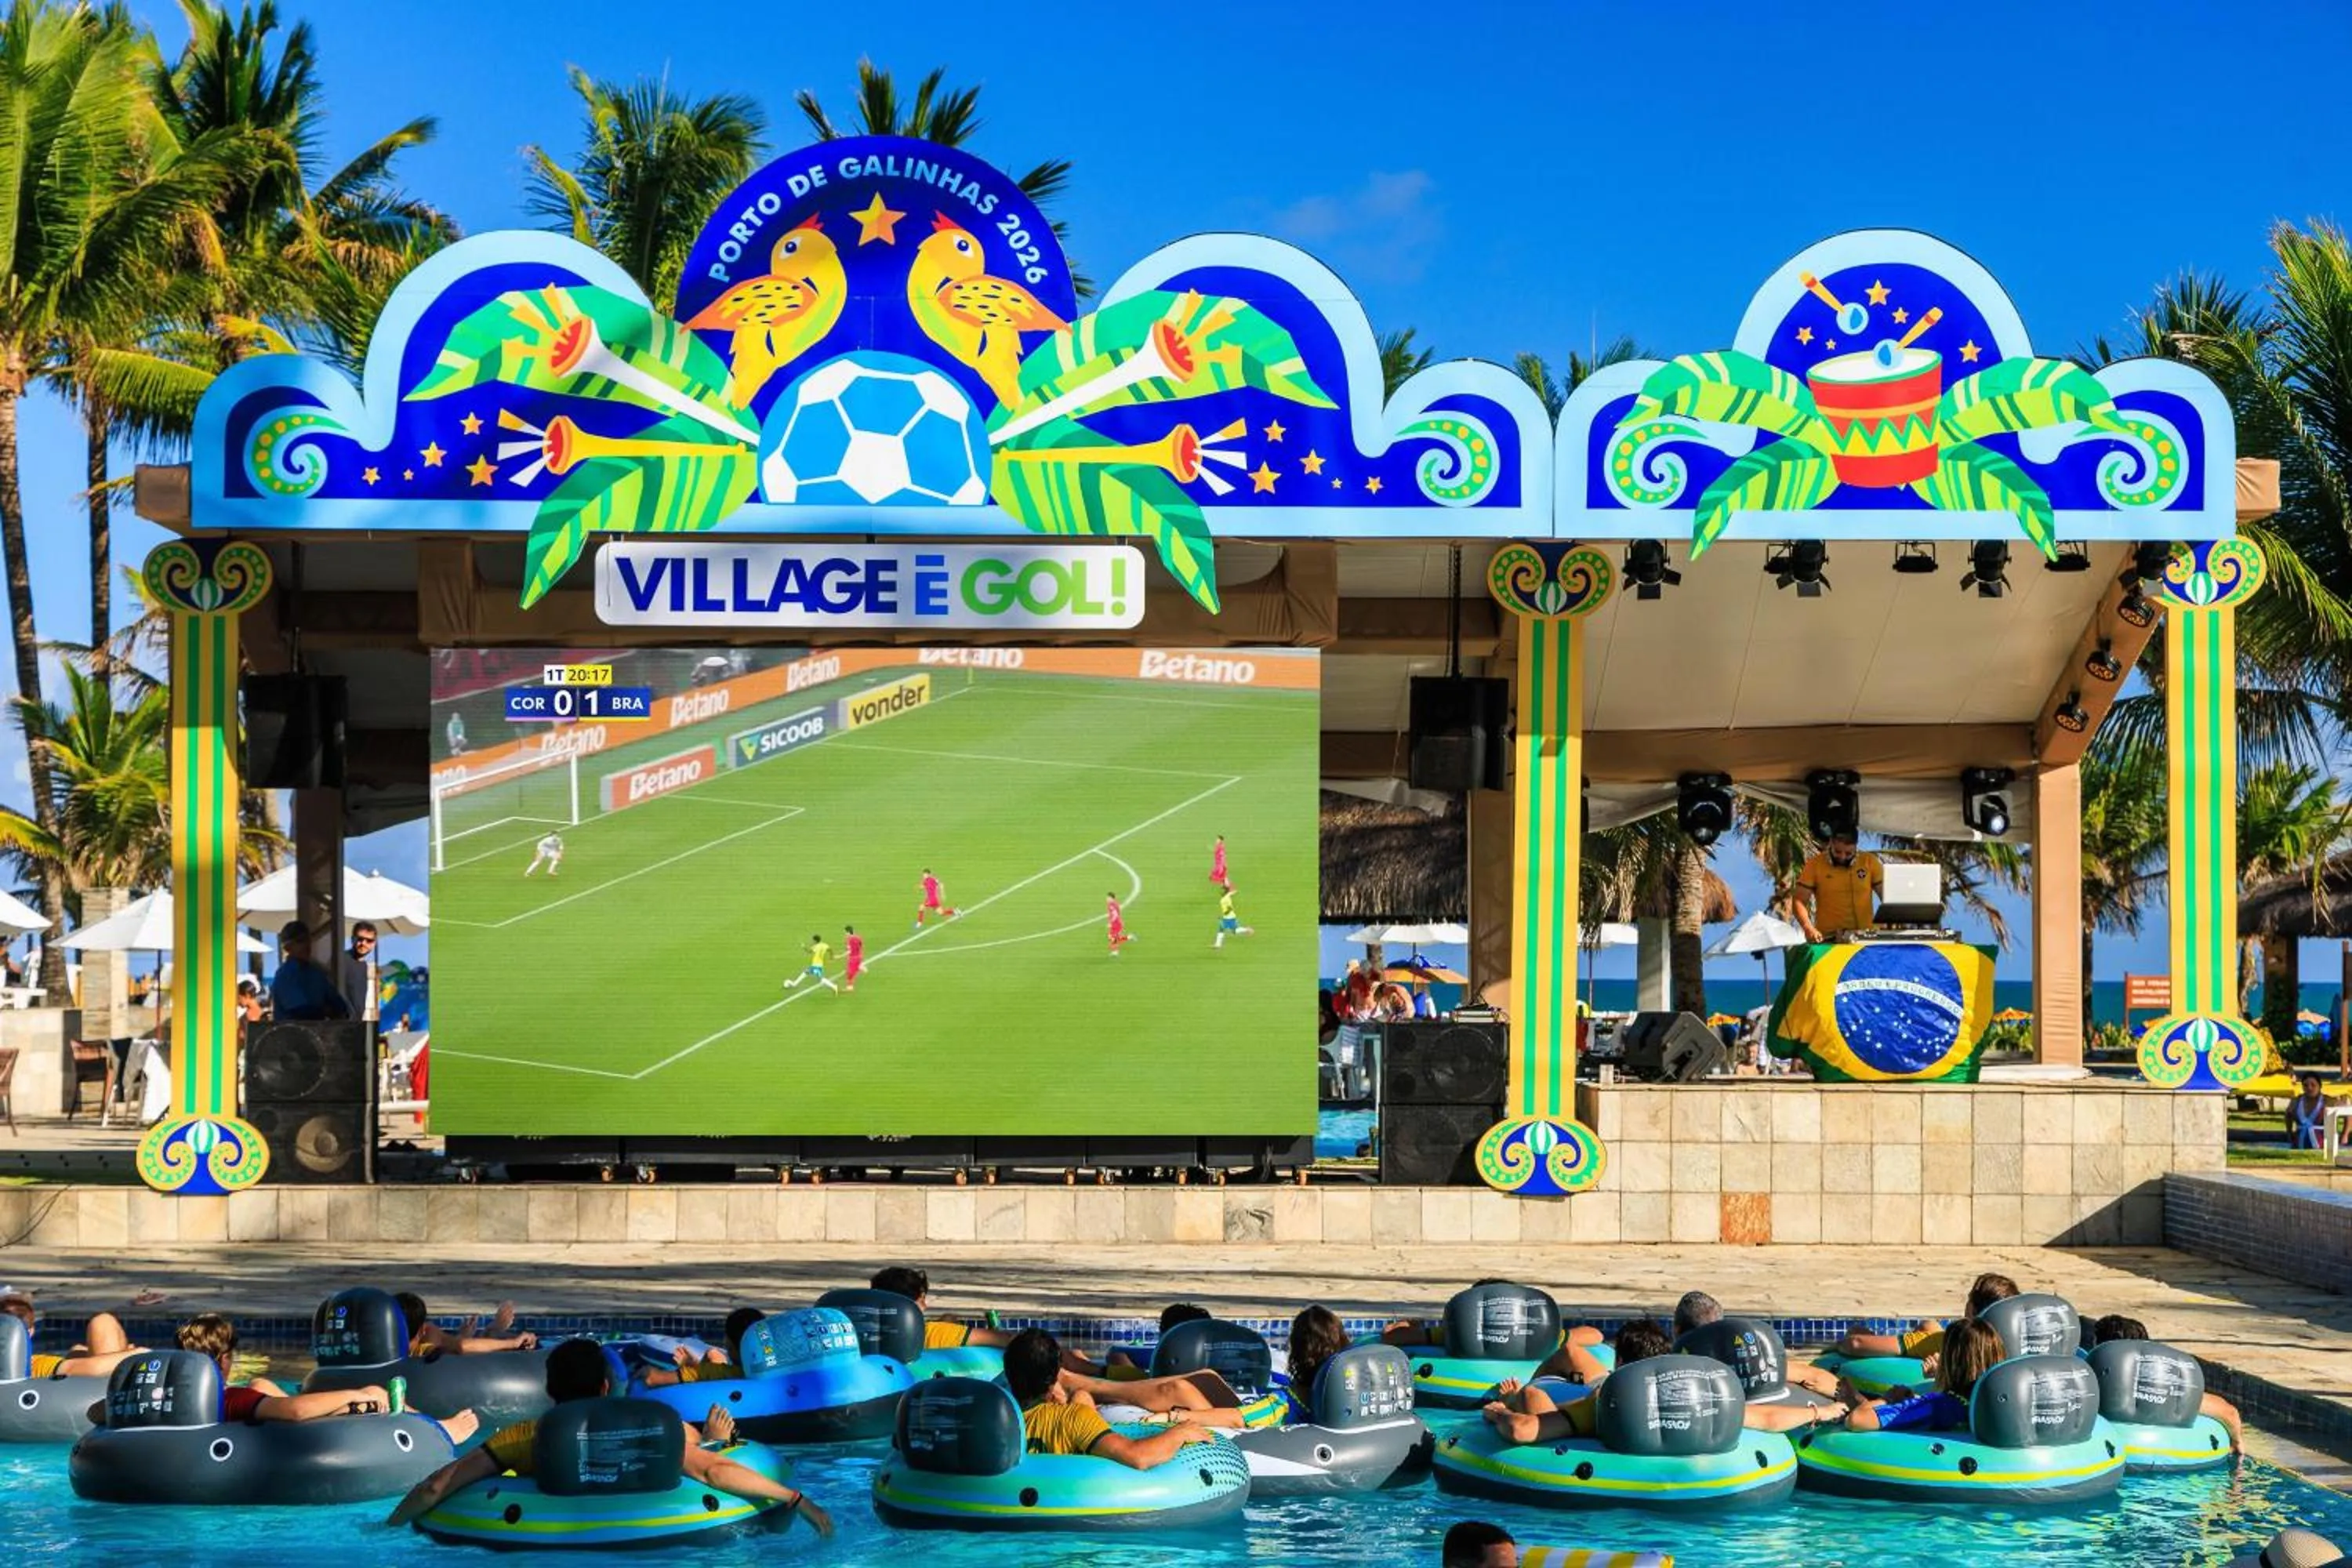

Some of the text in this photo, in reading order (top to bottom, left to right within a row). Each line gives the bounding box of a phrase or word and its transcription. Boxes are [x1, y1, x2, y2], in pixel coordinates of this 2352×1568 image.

[709, 154, 1048, 285] PORTO DE GALINHAS 2026
[615, 557, 898, 614] VILLAGE
[960, 557, 1126, 616] GOL!
[546, 669, 609, 681] 1T 20:17
[786, 655, 840, 692] Betano
[1141, 649, 1255, 684] Betano
[511, 690, 644, 716] COR 0 1 BRA
[670, 688, 730, 729] Betano
[852, 684, 926, 725] vonder
[760, 717, 825, 755] SICOOB
[629, 759, 702, 801] Betano
